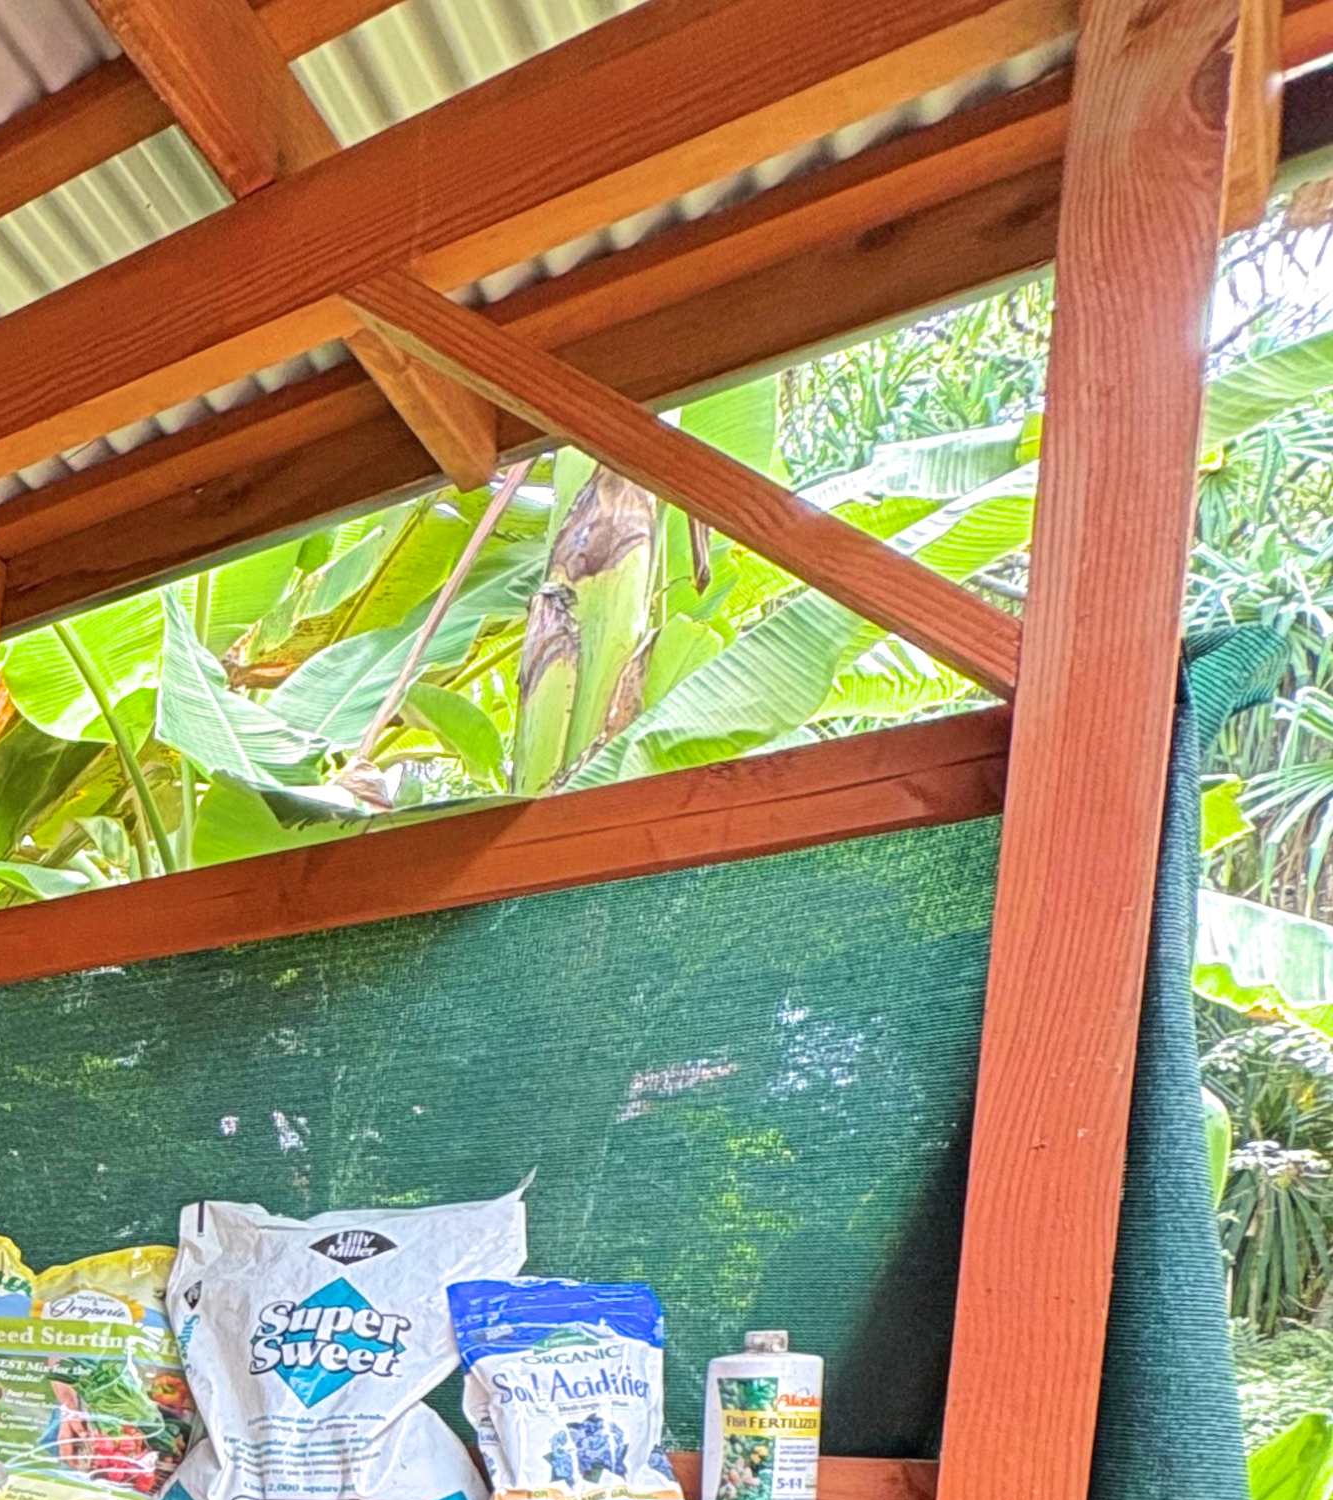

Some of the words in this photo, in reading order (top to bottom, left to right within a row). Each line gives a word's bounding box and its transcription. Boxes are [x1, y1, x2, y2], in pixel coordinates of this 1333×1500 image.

[336, 1231, 375, 1247] Lilly
[326, 1243, 379, 1259] Miller
[49, 1299, 127, 1318] Organic
[255, 1300, 413, 1346] Super
[249, 1335, 403, 1378] Sweet
[520, 1345, 621, 1365] ORGANIC
[26, 1362, 49, 1372] Mix
[52, 1363, 69, 1373] for
